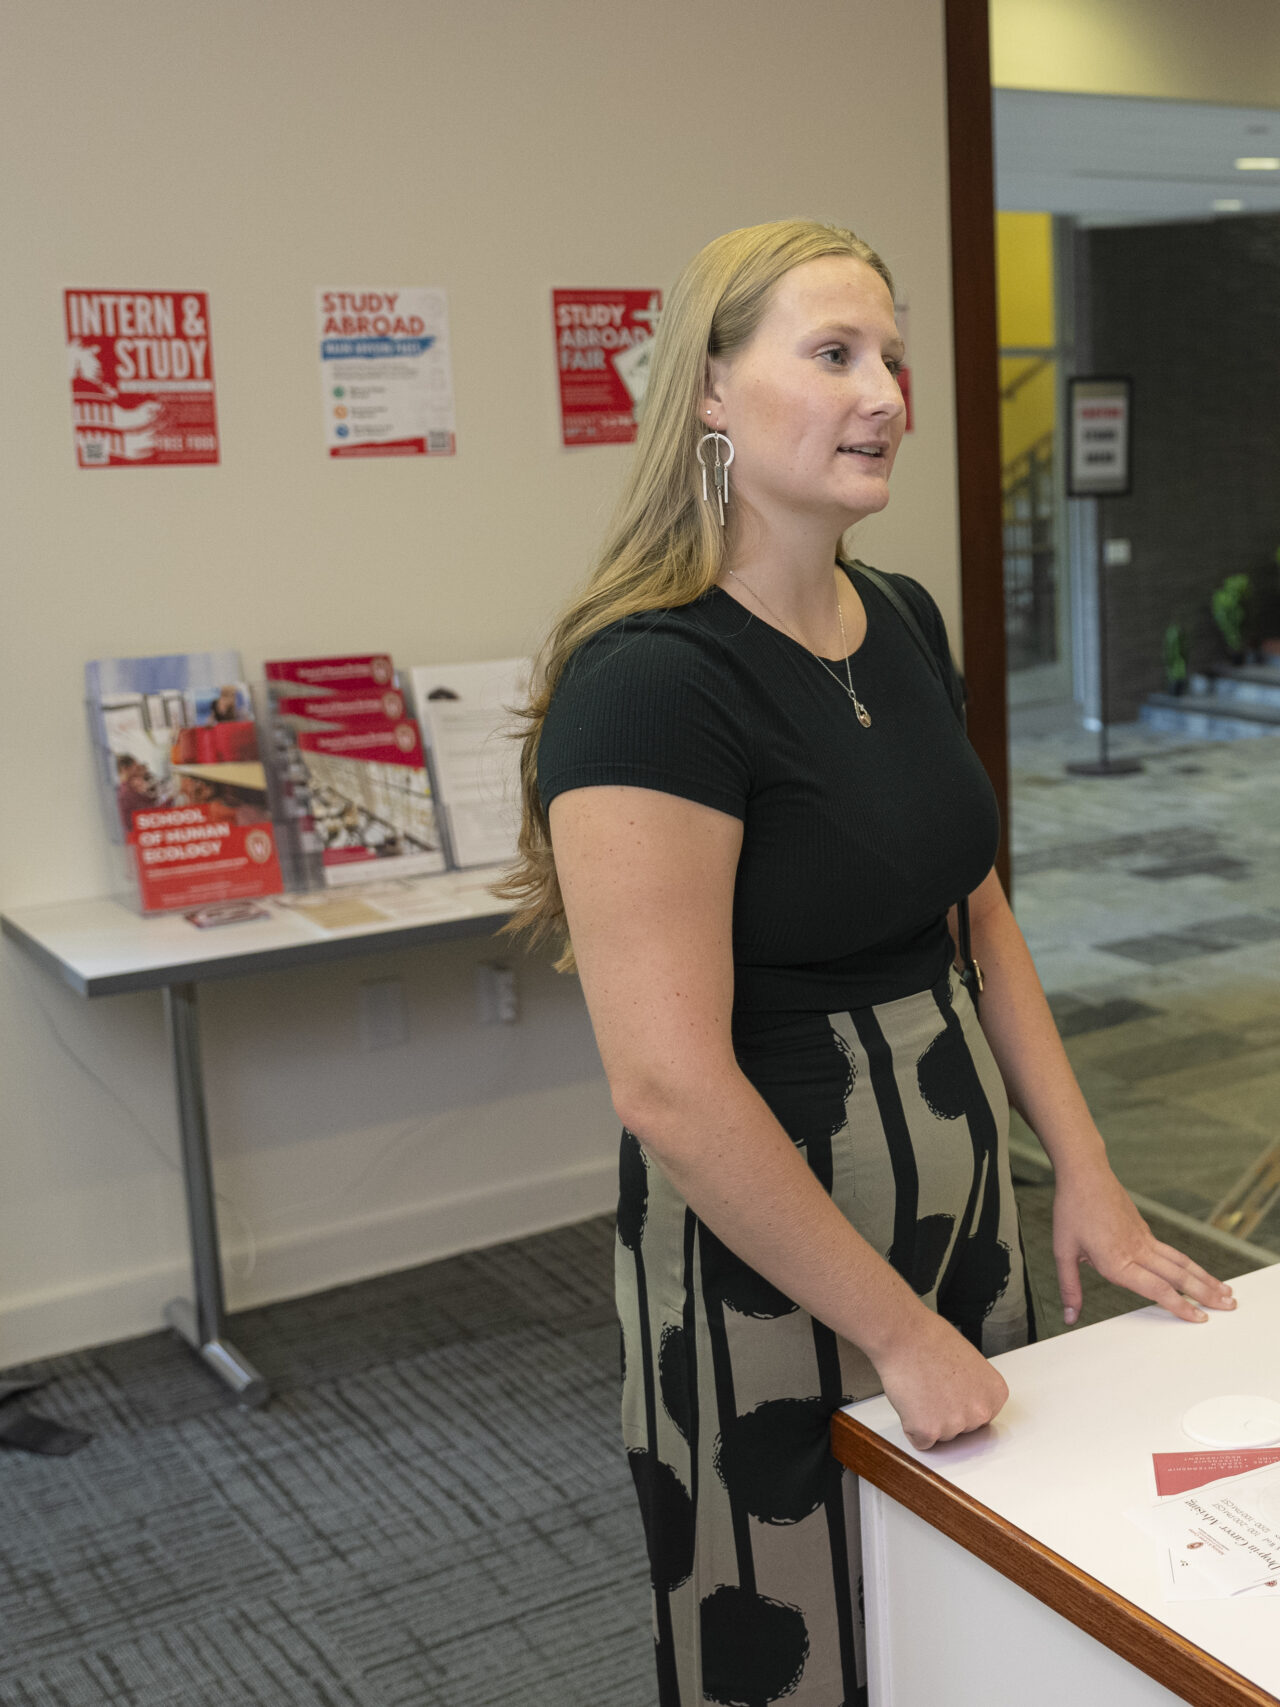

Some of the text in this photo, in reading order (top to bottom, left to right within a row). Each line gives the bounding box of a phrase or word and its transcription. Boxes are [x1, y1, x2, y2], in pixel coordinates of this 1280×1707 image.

[68, 293, 206, 337] INTERN &
[322, 293, 399, 314] STUDY
[324, 315, 426, 337] ABROAD
[558, 304, 626, 327] STUDY
[561, 326, 650, 349] ABROAD
[114, 337, 206, 380] STUDY
[561, 348, 607, 371] FAIR
[137, 808, 207, 830] SCHOOL
[139, 821, 231, 847] OF HUMAN
[142, 840, 222, 865] ECOLOGY
[1184, 1499, 1219, 1526] Advising
